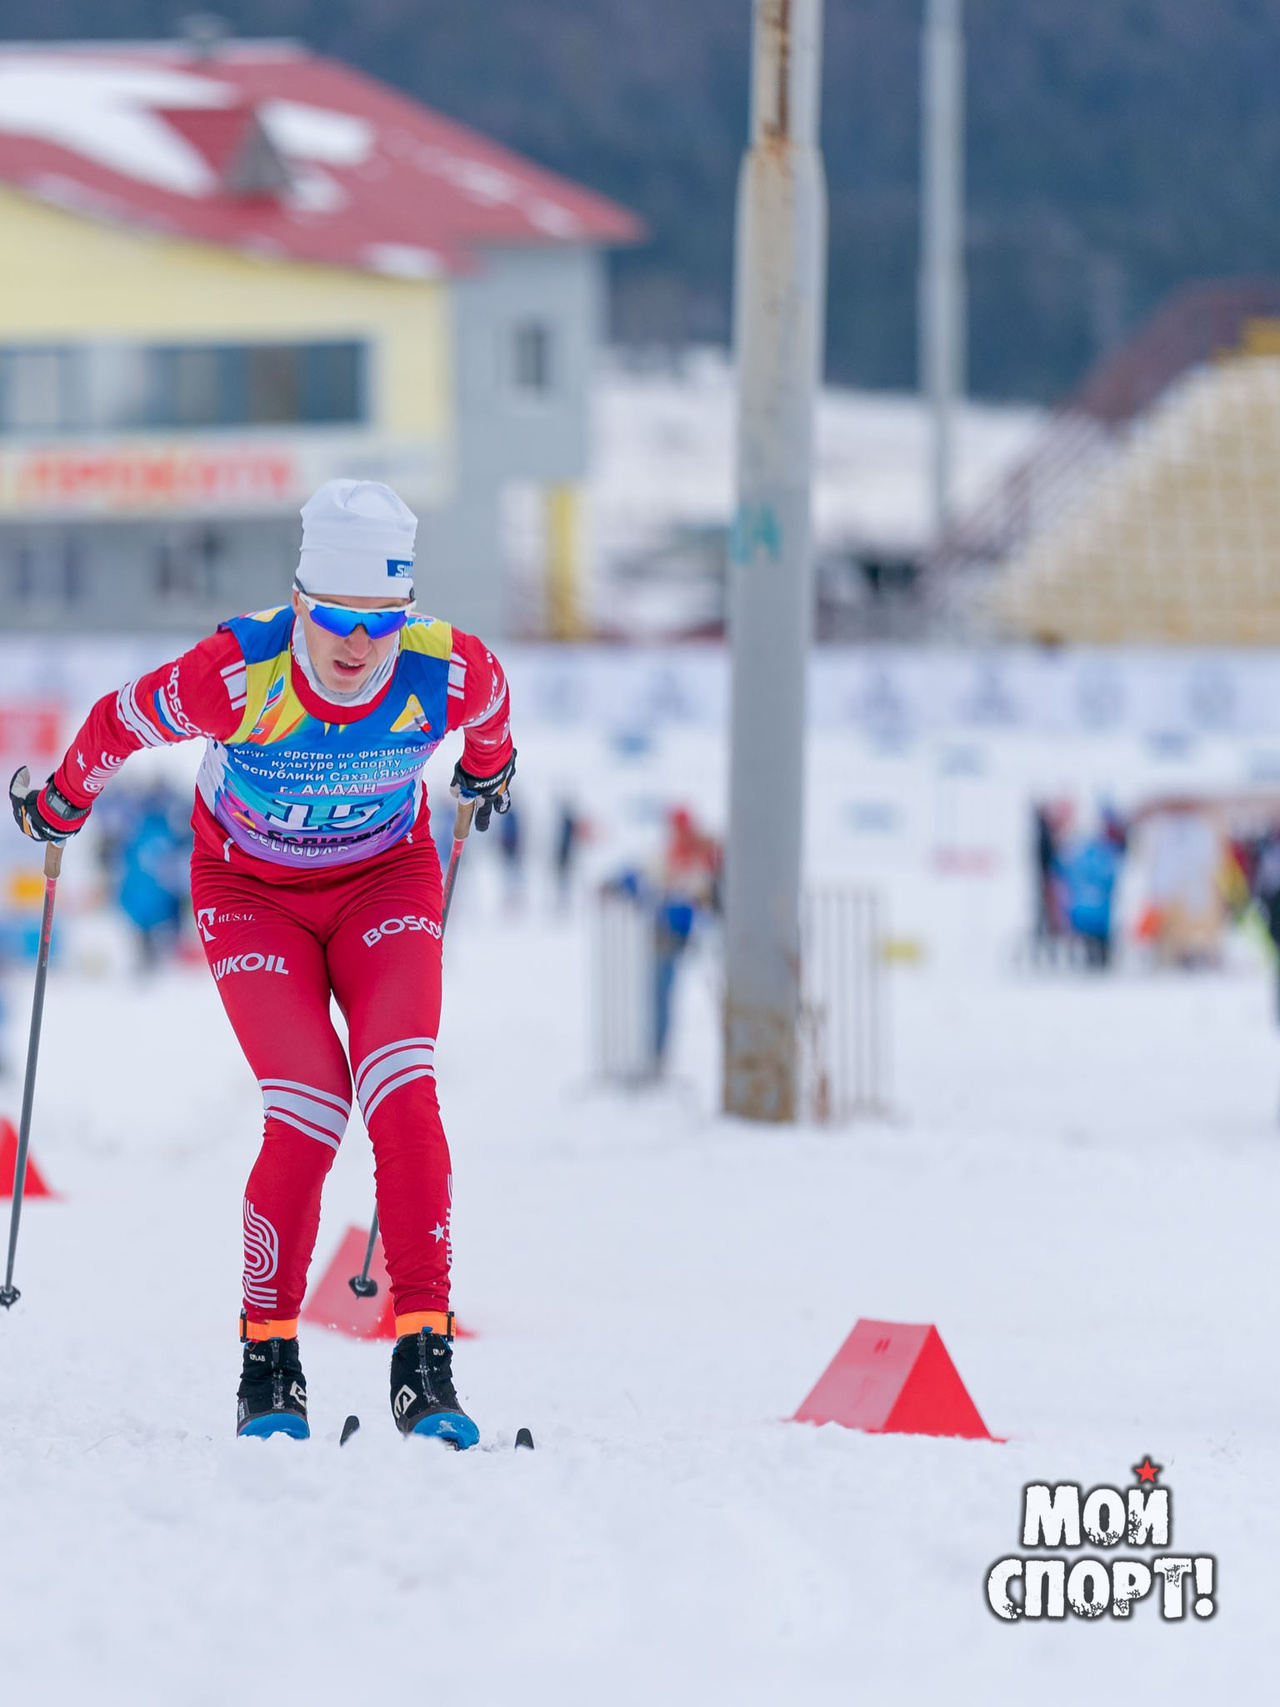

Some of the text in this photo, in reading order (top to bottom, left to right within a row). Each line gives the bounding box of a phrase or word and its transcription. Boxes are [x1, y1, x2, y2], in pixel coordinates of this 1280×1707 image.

[337, 752, 354, 760] по
[271, 758, 401, 771] культуре и спорту
[329, 771, 369, 782] Саха
[301, 782, 377, 797] АЛДАН
[266, 797, 384, 832] 15
[218, 913, 256, 924] RUSAL
